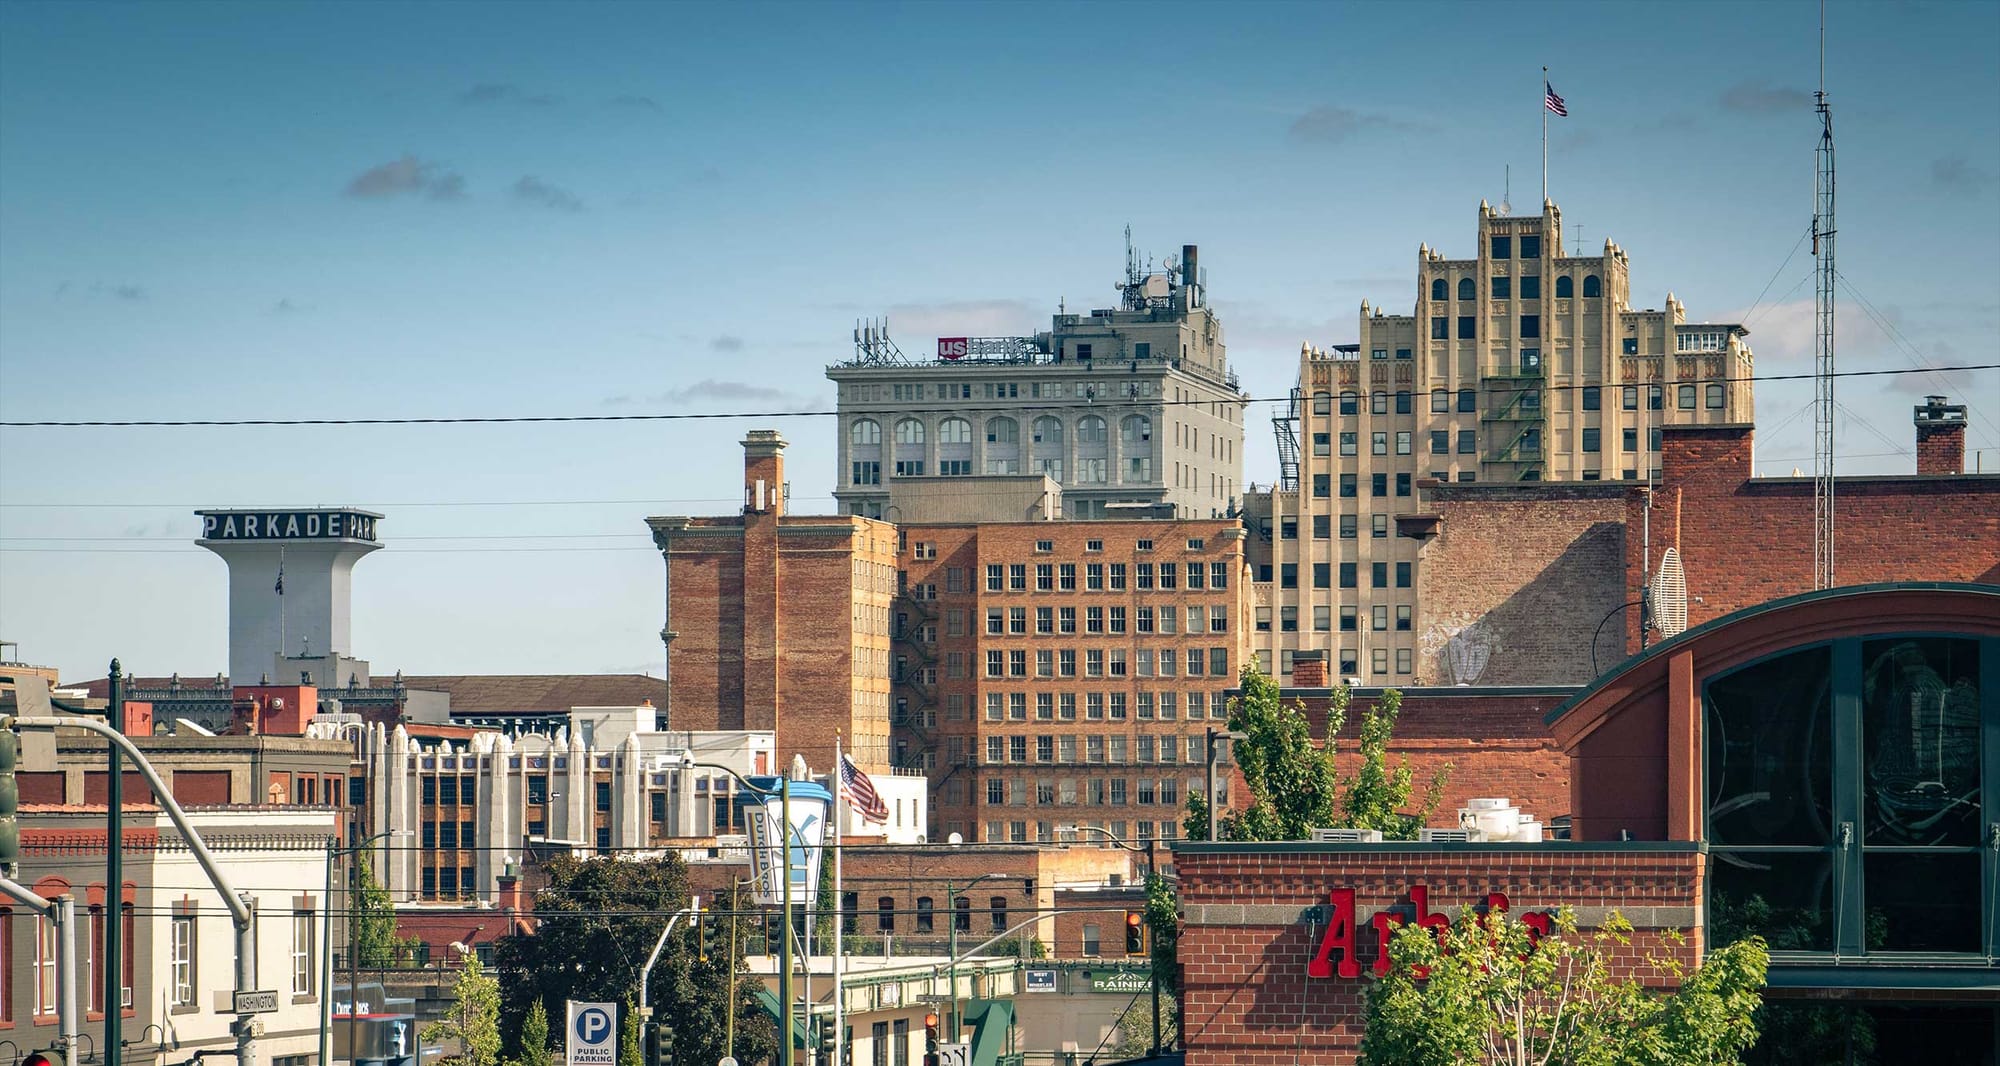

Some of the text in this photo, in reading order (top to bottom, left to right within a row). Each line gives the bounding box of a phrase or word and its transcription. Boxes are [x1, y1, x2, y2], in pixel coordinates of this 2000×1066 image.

[205, 514, 341, 538] PARKADE
[755, 812, 770, 898] DUTCH BROS
[238, 995, 277, 1009] WASHINGTON
[585, 1013, 606, 1040] P
